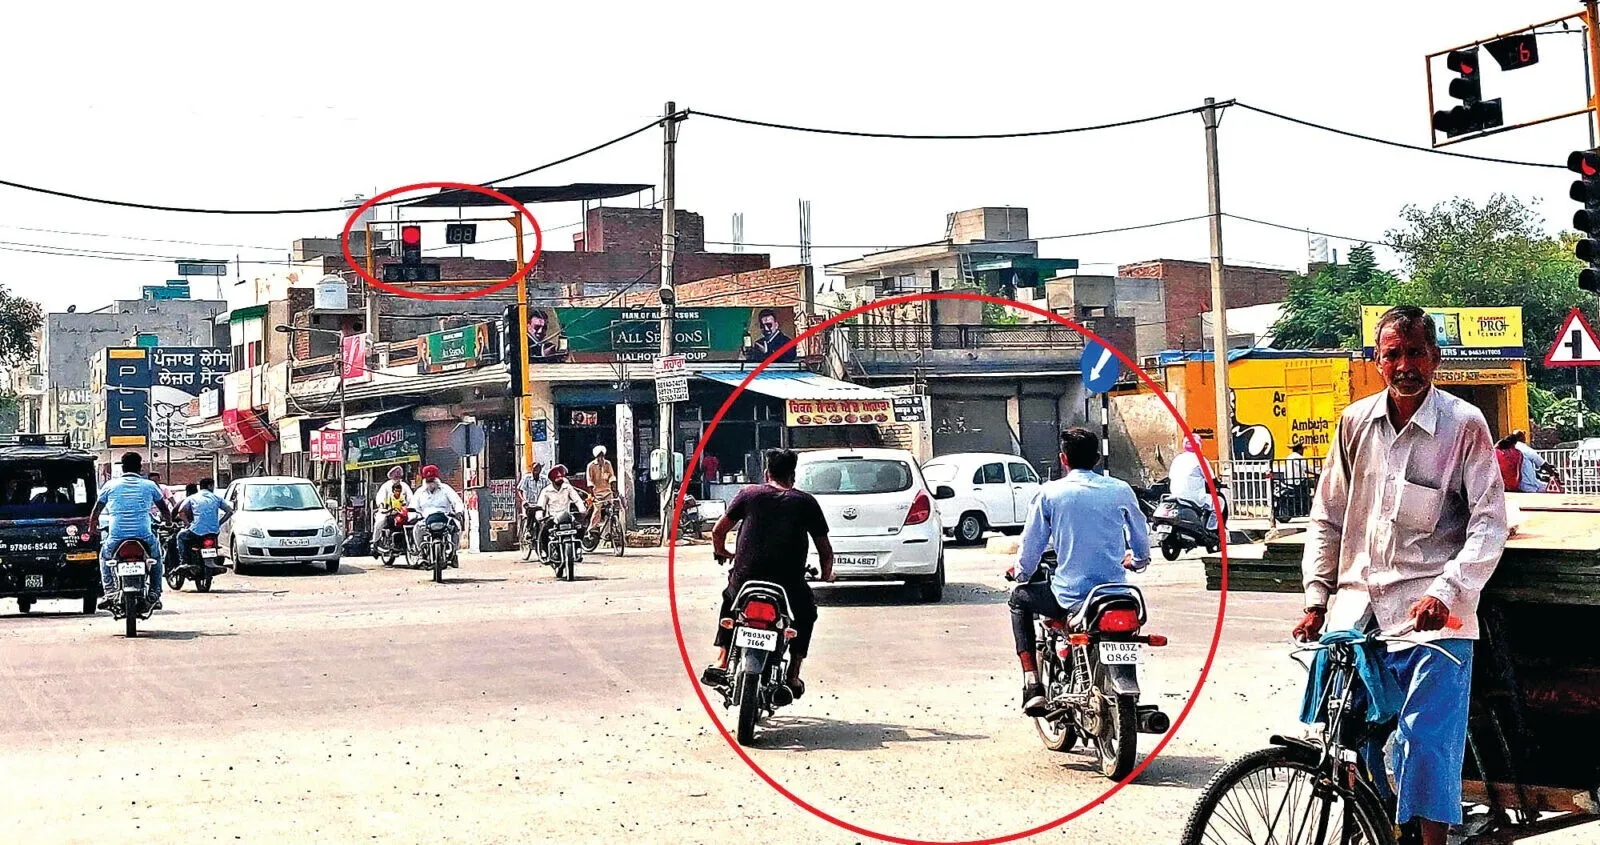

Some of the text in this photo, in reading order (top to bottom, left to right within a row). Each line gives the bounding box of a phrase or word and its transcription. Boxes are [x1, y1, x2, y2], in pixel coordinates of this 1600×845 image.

[1520, 42, 1530, 62] 6
[616, 330, 703, 343] ALL SEONS
[153, 349, 195, 366] ਪੰਜਾਬ
[616, 352, 660, 361] MALHOT
[1292, 418, 1329, 433] Ambuja
[1291, 433, 1330, 445] Cement
[1106, 653, 1138, 661] 0865
